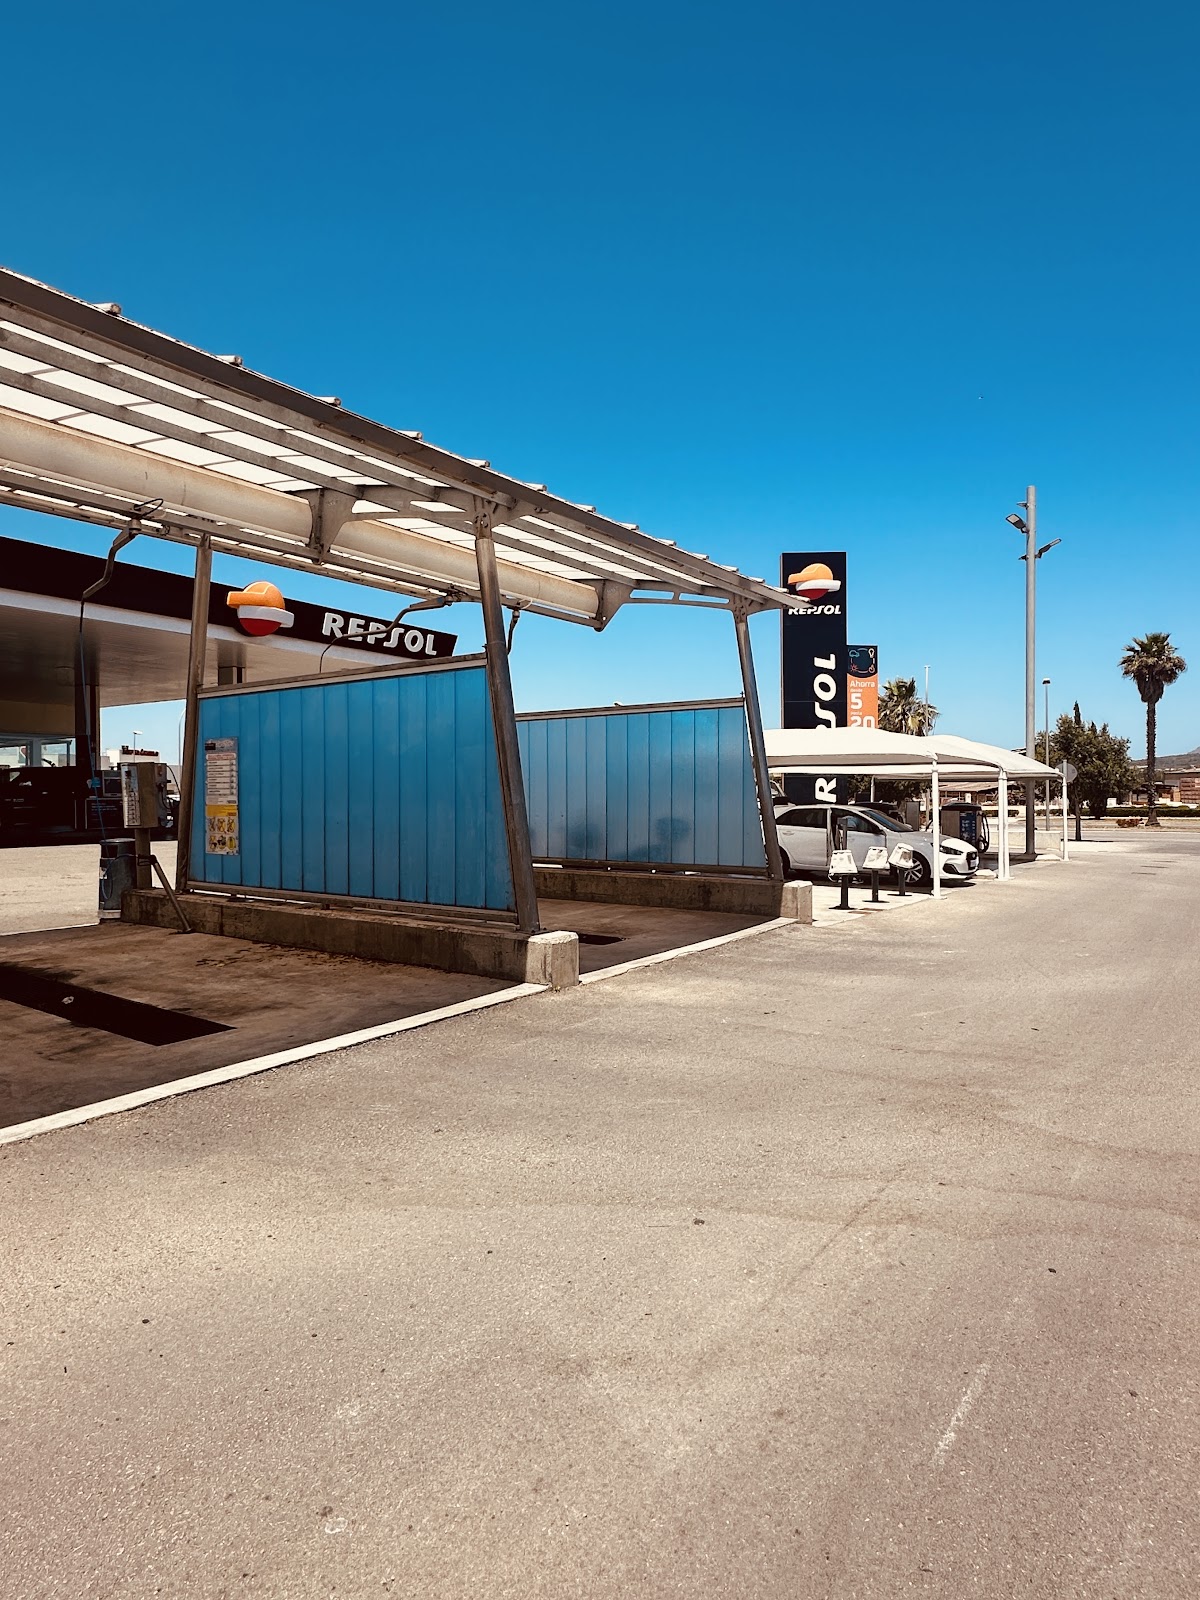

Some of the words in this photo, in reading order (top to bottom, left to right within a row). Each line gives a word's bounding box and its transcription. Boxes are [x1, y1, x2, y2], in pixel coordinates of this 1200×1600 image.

[321, 612, 437, 656] REPSOL
[850, 680, 876, 688] Ahorra
[850, 693, 863, 710] 5
